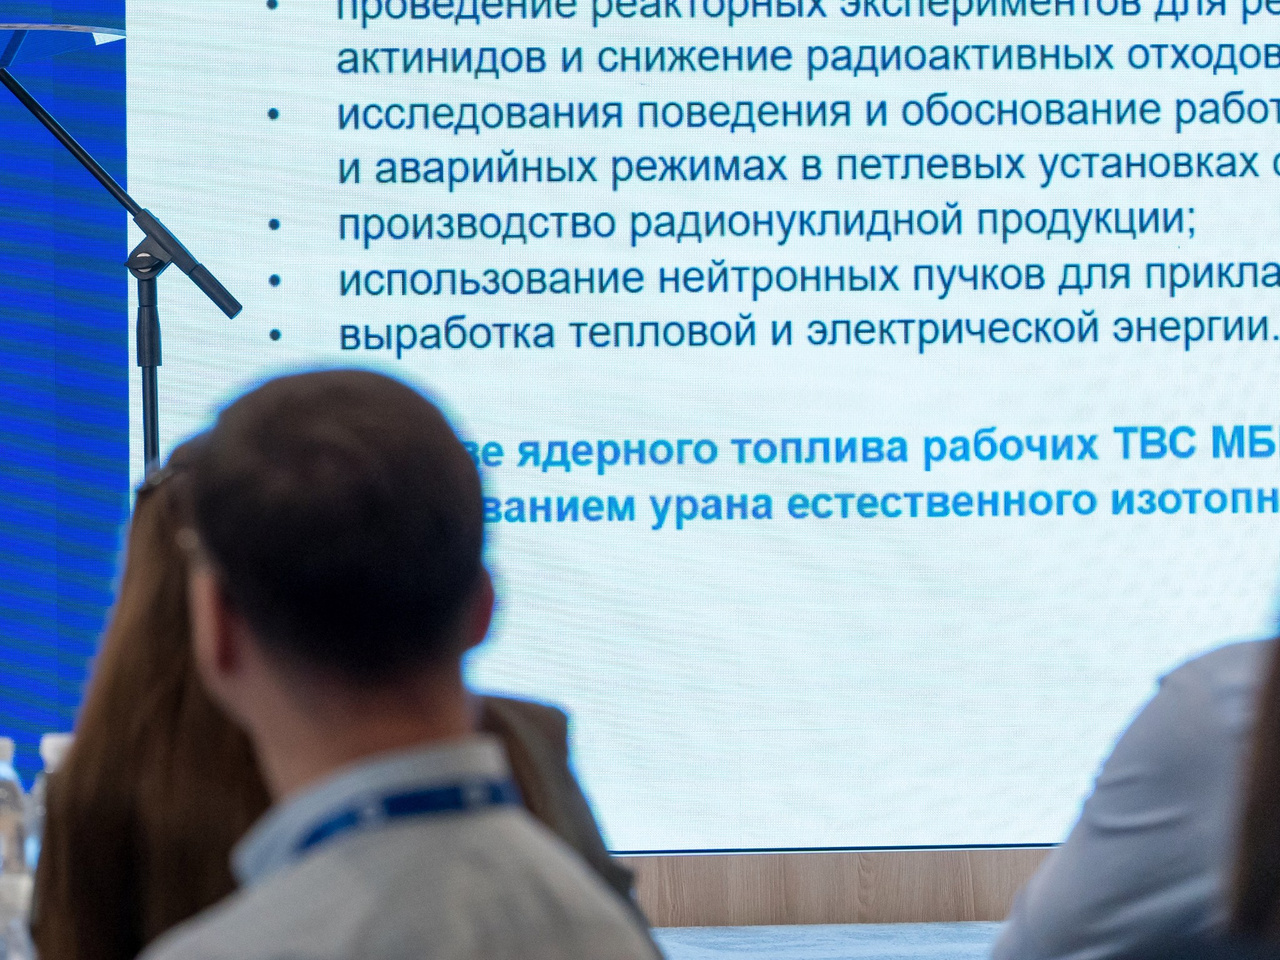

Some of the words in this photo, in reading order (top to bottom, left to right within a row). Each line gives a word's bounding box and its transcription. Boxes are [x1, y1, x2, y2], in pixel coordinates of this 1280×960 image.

[337, 47, 547, 79] актинидов
[562, 47, 583, 73] и
[598, 46, 793, 72] снижение
[808, 44, 1114, 81] радиоактивных
[1128, 43, 1280, 75] отходов
[339, 102, 623, 135] исследования
[638, 100, 851, 133] поведения
[866, 100, 887, 127] и
[902, 91, 1161, 126] обоснование
[339, 158, 360, 184] и
[376, 149, 597, 193] аварийных
[612, 155, 788, 192] режимах
[802, 155, 823, 180] в
[837, 154, 1026, 180] петлевых
[1038, 152, 1260, 189] установках
[340, 212, 616, 250] производство
[631, 201, 962, 248] радионуклидной
[978, 207, 1195, 244] продукции;
[340, 267, 644, 296] использование
[659, 259, 900, 302] нейтронных
[914, 264, 1045, 300] пучков
[1058, 263, 1130, 296] для
[1146, 262, 1280, 298] прикла
[341, 314, 555, 360] выработка
[569, 312, 756, 348] тепловой
[772, 320, 792, 346] и
[807, 309, 1099, 354] электрической
[1113, 316, 1280, 352] энергии.
[517, 439, 718, 476] ядерного
[730, 436, 908, 465] топлива
[924, 426, 1099, 472] рабочих
[1113, 425, 1196, 460] ТВС
[1212, 425, 1280, 459] МБ
[483, 495, 635, 523] ванием
[650, 493, 773, 531] урана
[787, 490, 1098, 519] естественного
[1112, 488, 1280, 515] изотопн
